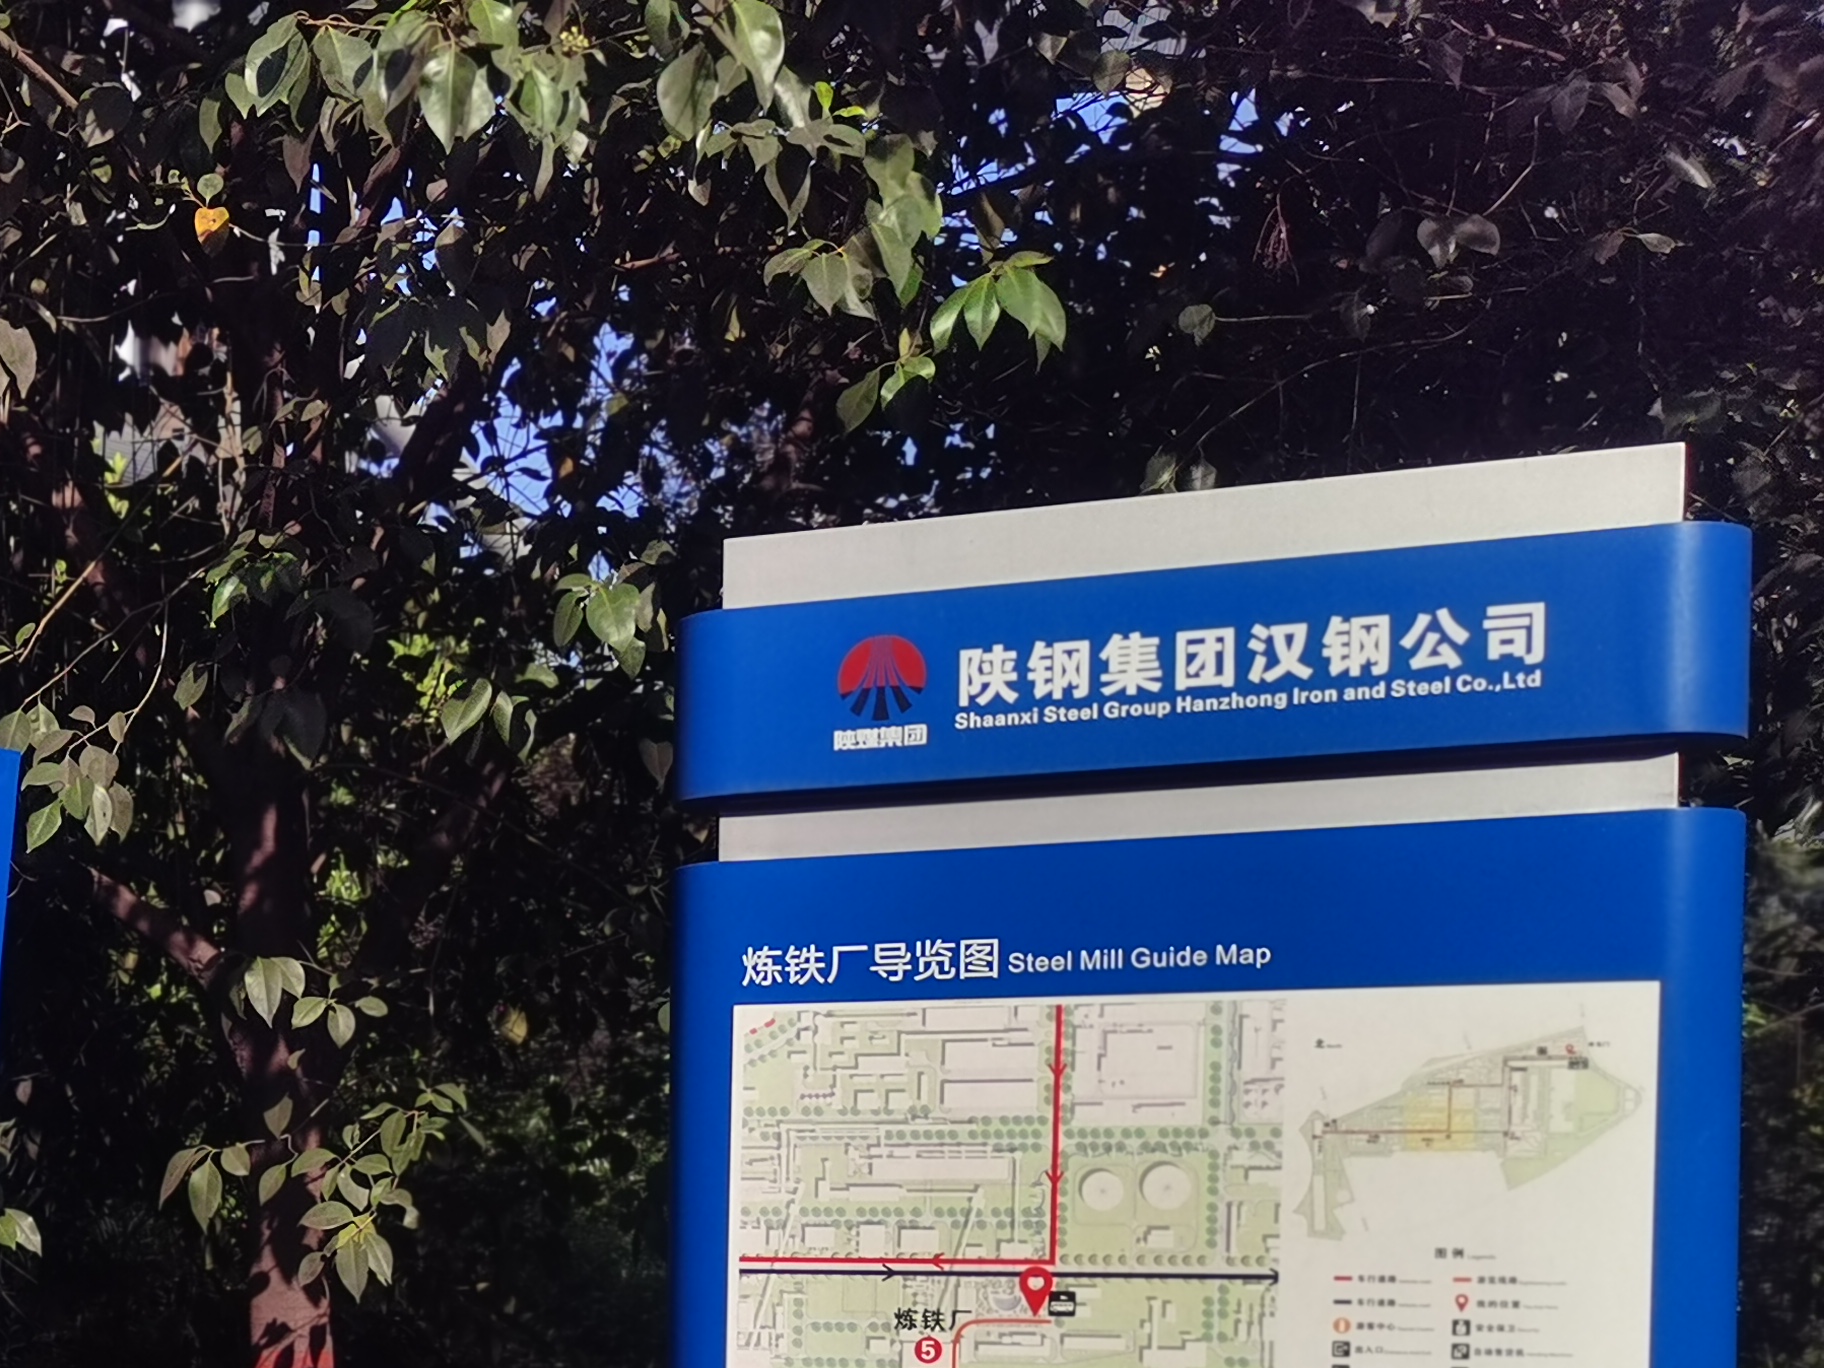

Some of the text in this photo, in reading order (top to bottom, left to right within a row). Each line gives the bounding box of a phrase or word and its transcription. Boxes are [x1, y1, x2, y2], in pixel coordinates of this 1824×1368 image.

[957, 601, 1547, 706] 陕钢集团汉钢公司
[954, 669, 1542, 731] Shaanxi Steel Group Hanzhong Iron and Steel Co.,Ltd
[741, 938, 1272, 988] 炼铁厂导览图 Steel Mill Guide Map
[894, 1307, 972, 1332] 炼铁厂
